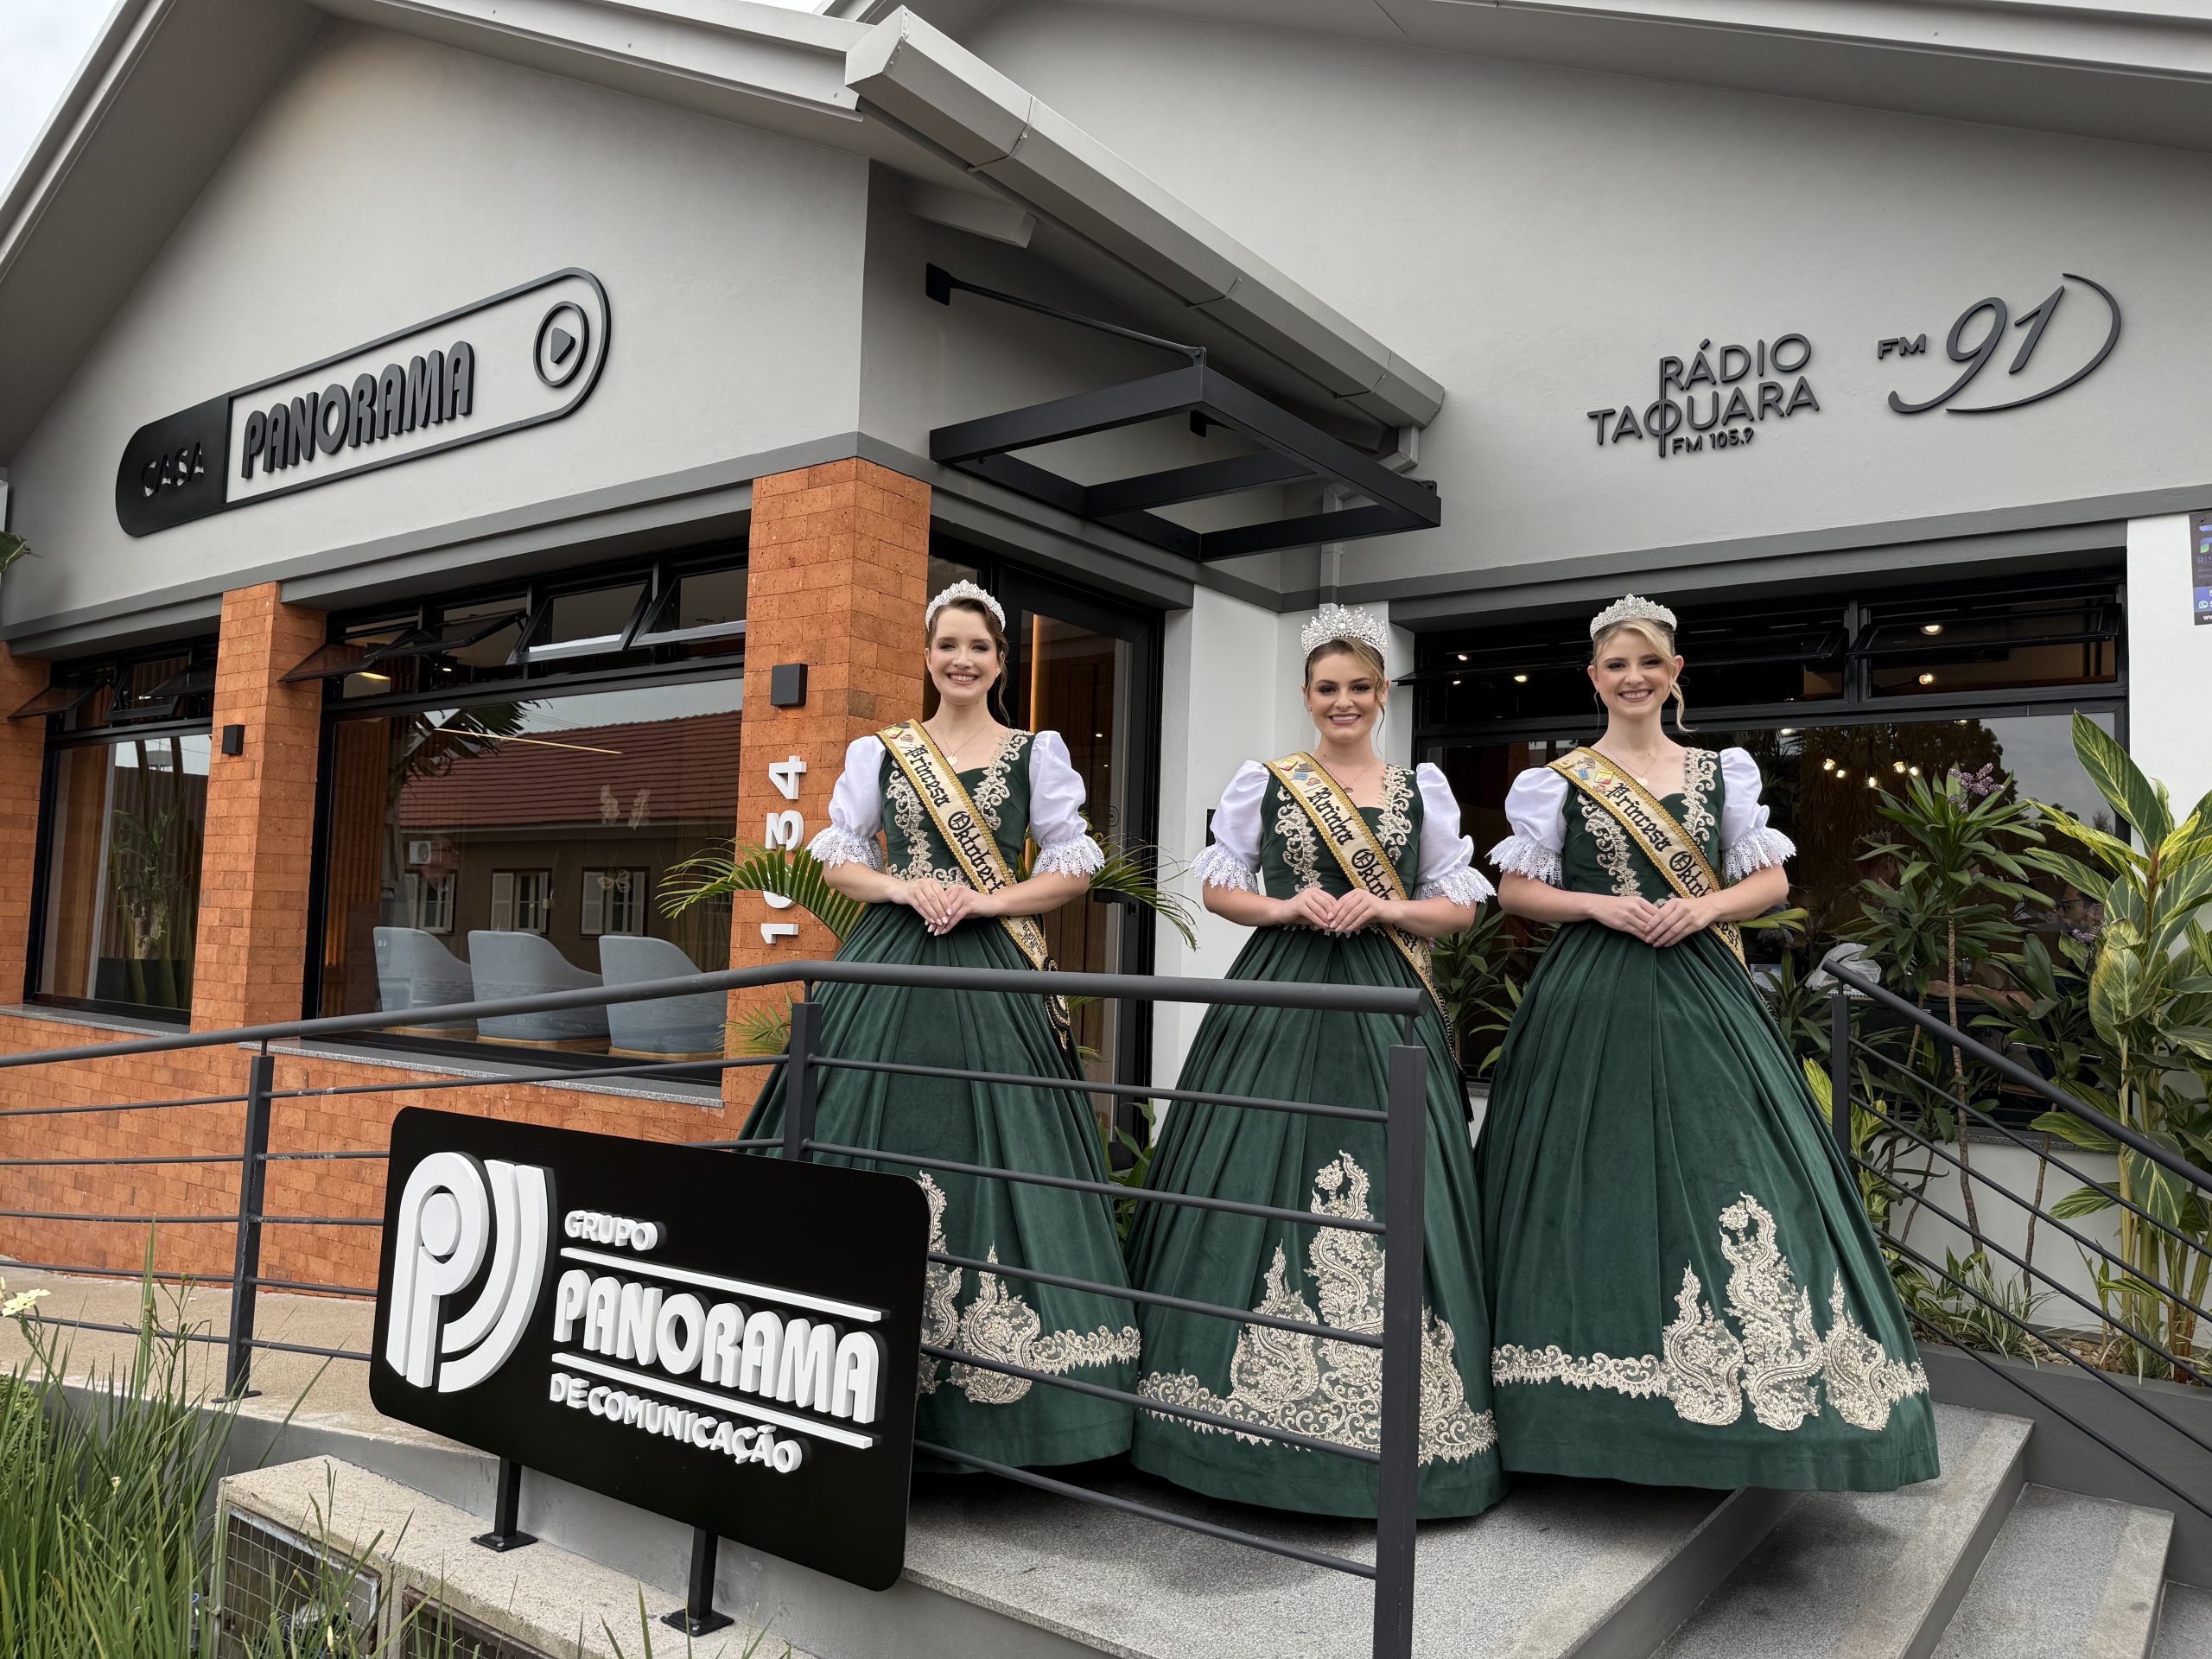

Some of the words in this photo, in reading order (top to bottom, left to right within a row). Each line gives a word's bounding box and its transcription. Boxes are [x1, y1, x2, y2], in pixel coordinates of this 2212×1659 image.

[1659, 333, 1812, 391] RÁDIO
[1877, 333, 1927, 359] FM
[1887, 285, 2065, 414] 91
[141, 442, 205, 498] CASA
[241, 340, 474, 480] PANORAMA
[1586, 375, 1820, 458] TAQUARA
[1672, 435, 1702, 454] FM
[1708, 426, 1754, 449] 105.9
[903, 744, 951, 808] Princesa
[947, 810, 1008, 896] Oktoberf
[1306, 786, 1355, 846] Rainha
[1605, 782, 1673, 853] Princesa
[563, 1209, 659, 1252] GRUPO
[553, 1268, 880, 1424] PANORAMA
[588, 1385, 803, 1473] COMUNICAÇÃO
